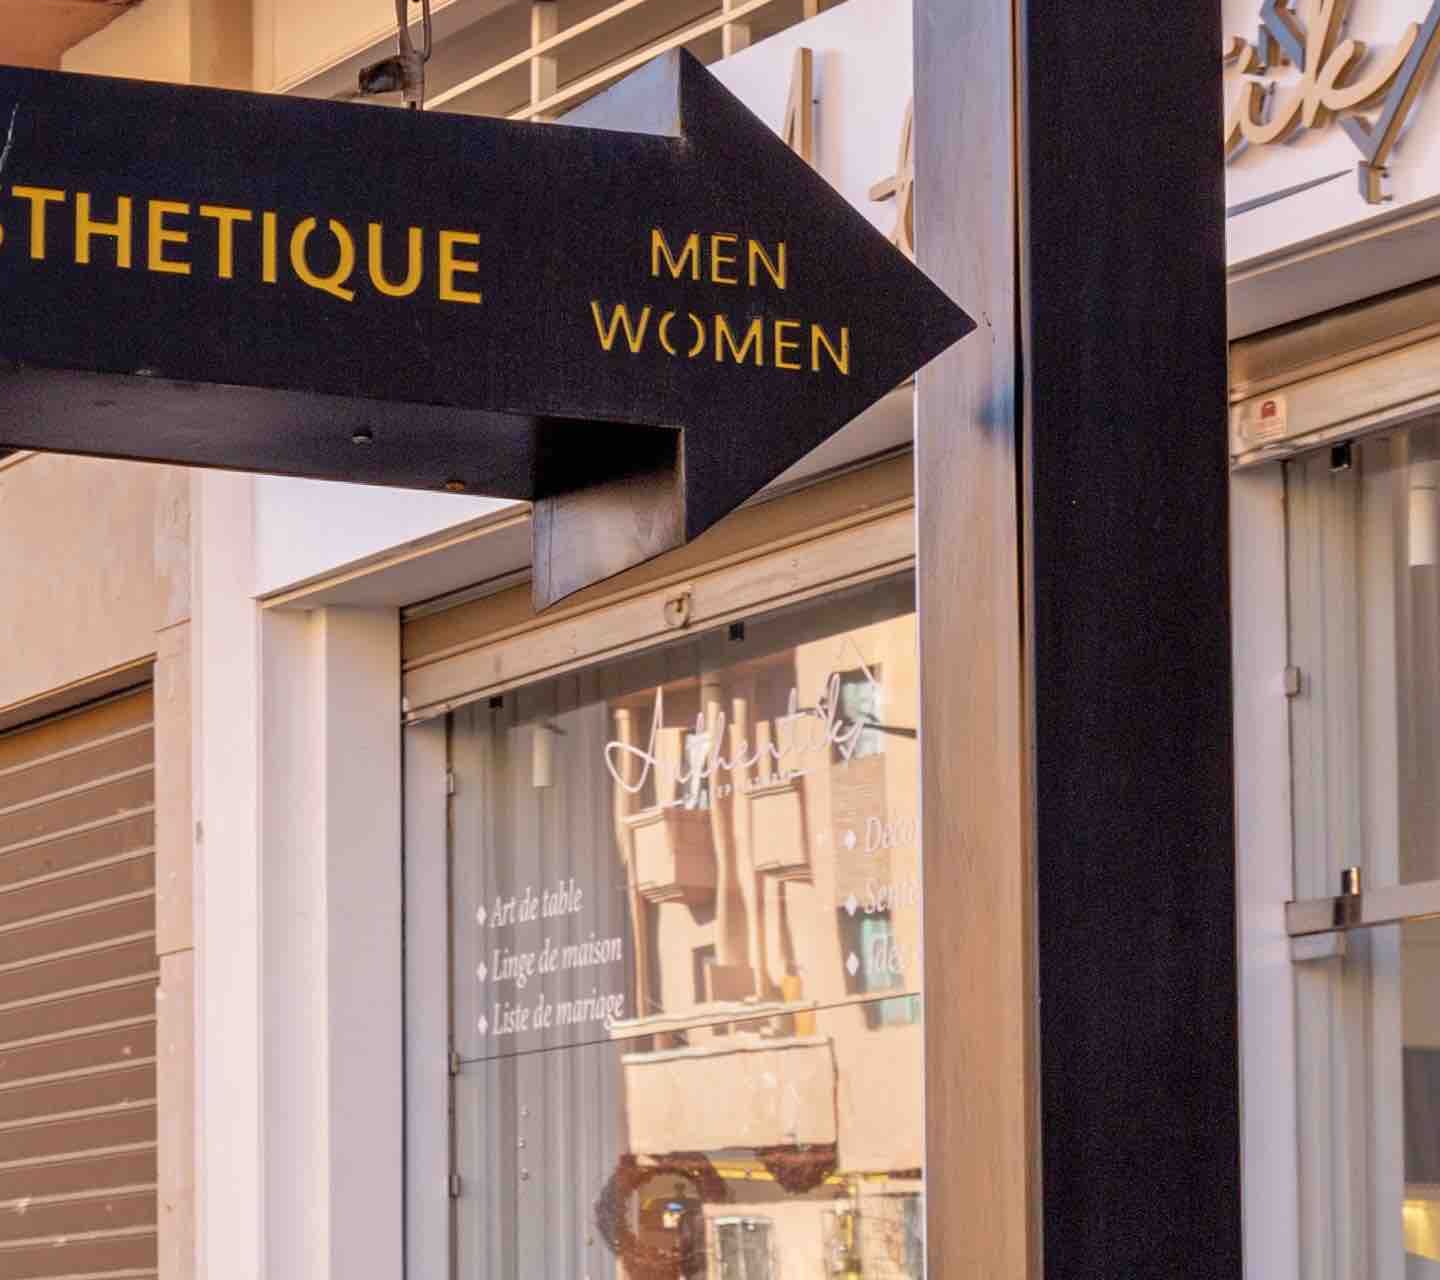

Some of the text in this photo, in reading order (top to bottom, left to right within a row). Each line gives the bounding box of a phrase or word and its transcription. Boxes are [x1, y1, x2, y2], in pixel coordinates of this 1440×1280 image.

[650, 228, 787, 290] MEN
[590, 300, 850, 376] WOMEN
[488, 877, 584, 928] Art de table
[492, 931, 622, 989] Linge de maison
[492, 987, 624, 1035] Liste de mariage
